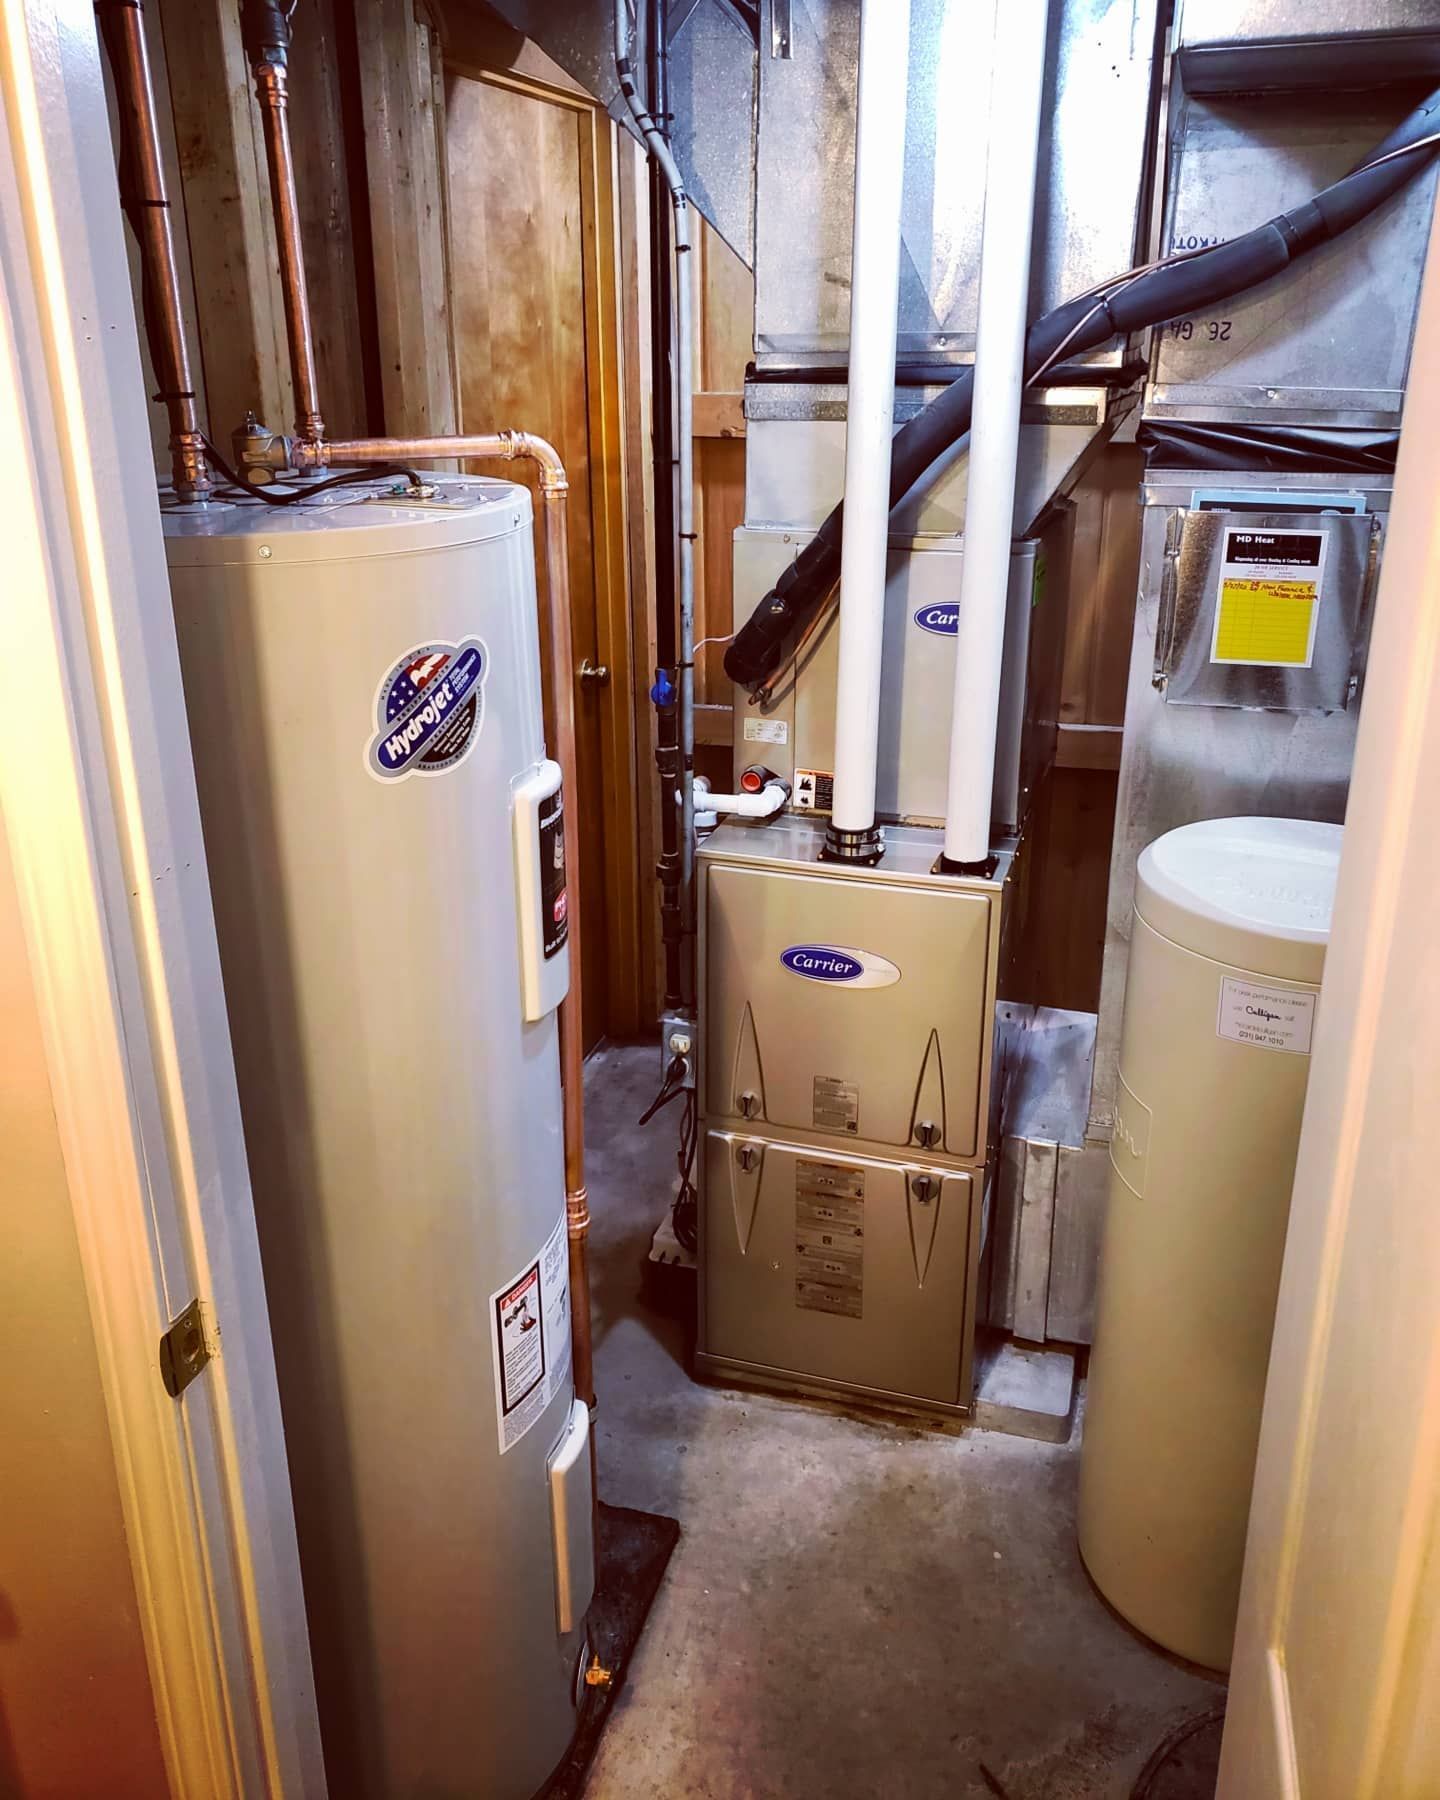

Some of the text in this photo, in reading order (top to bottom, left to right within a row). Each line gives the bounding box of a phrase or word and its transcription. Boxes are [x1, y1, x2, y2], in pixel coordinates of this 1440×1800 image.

[1170, 321, 1232, 341] 26 GA
[1235, 535, 1275, 544] MD Heat
[926, 610, 960, 624] Car
[385, 681, 453, 761] Hydrojet
[793, 953, 853, 973] Carrier
[1245, 1005, 1282, 1022] Culligan
[1238, 1030, 1254, 1040] (231)
